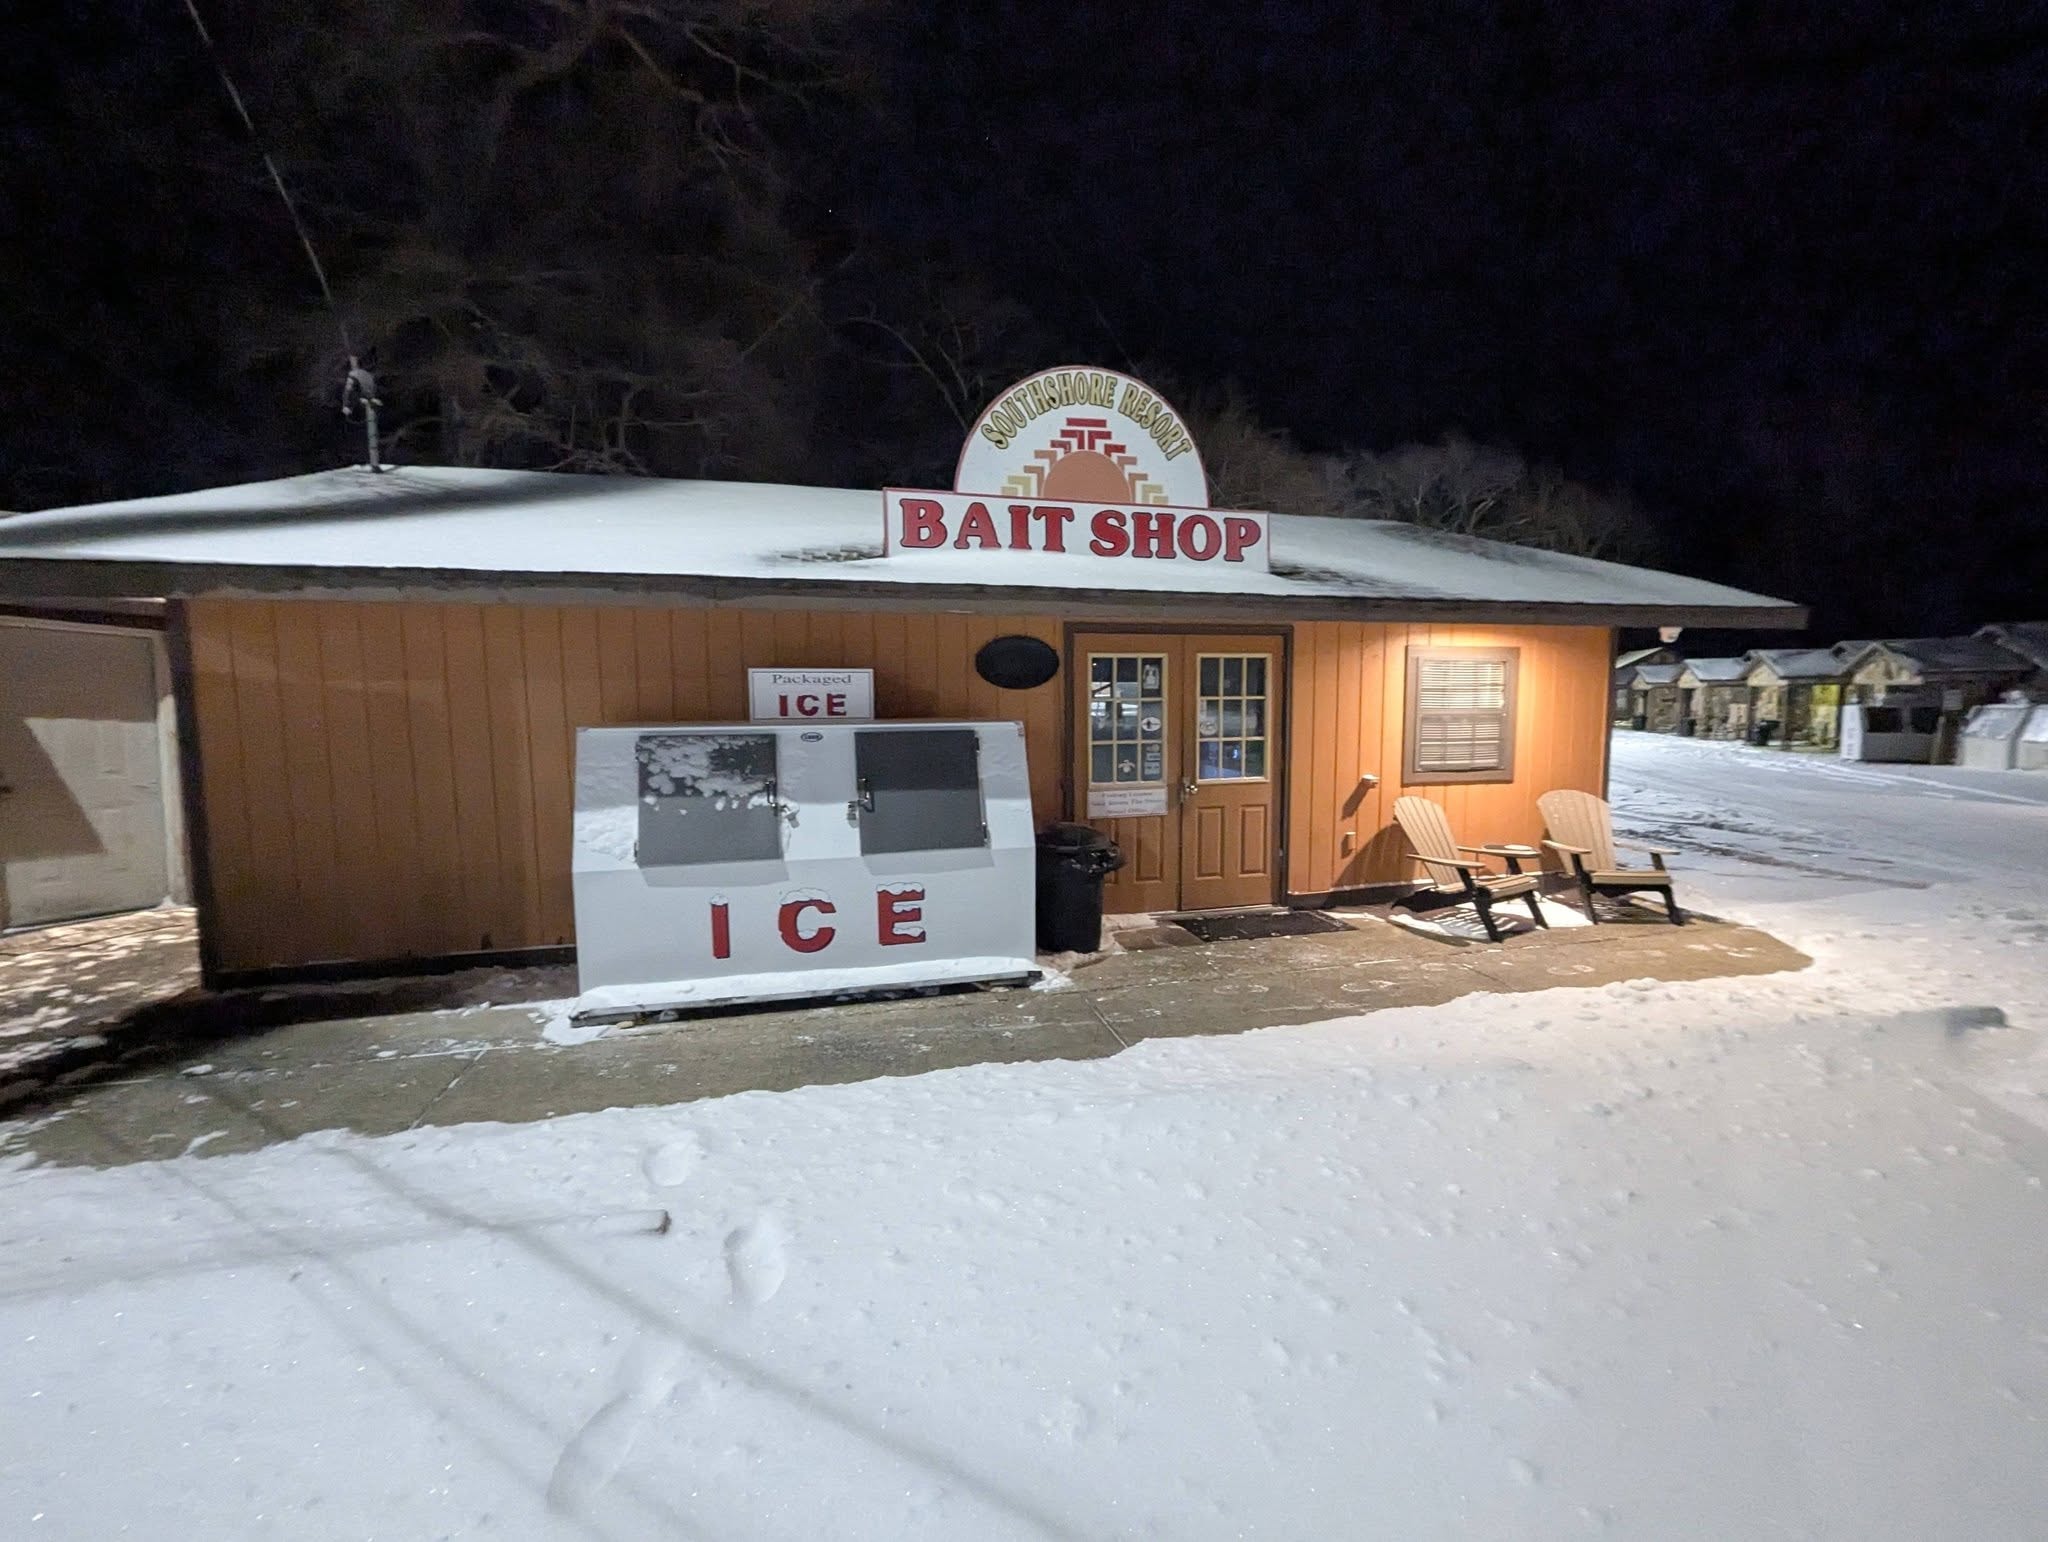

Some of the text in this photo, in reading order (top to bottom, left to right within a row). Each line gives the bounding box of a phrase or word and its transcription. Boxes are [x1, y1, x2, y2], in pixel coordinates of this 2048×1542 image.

[981, 371, 1193, 461] SOUTHSHORE RESORT
[900, 498, 1262, 562] BAIT SHOP
[772, 674, 852, 686] Packaged
[779, 693, 847, 717] ICE
[711, 882, 926, 959] ICE
